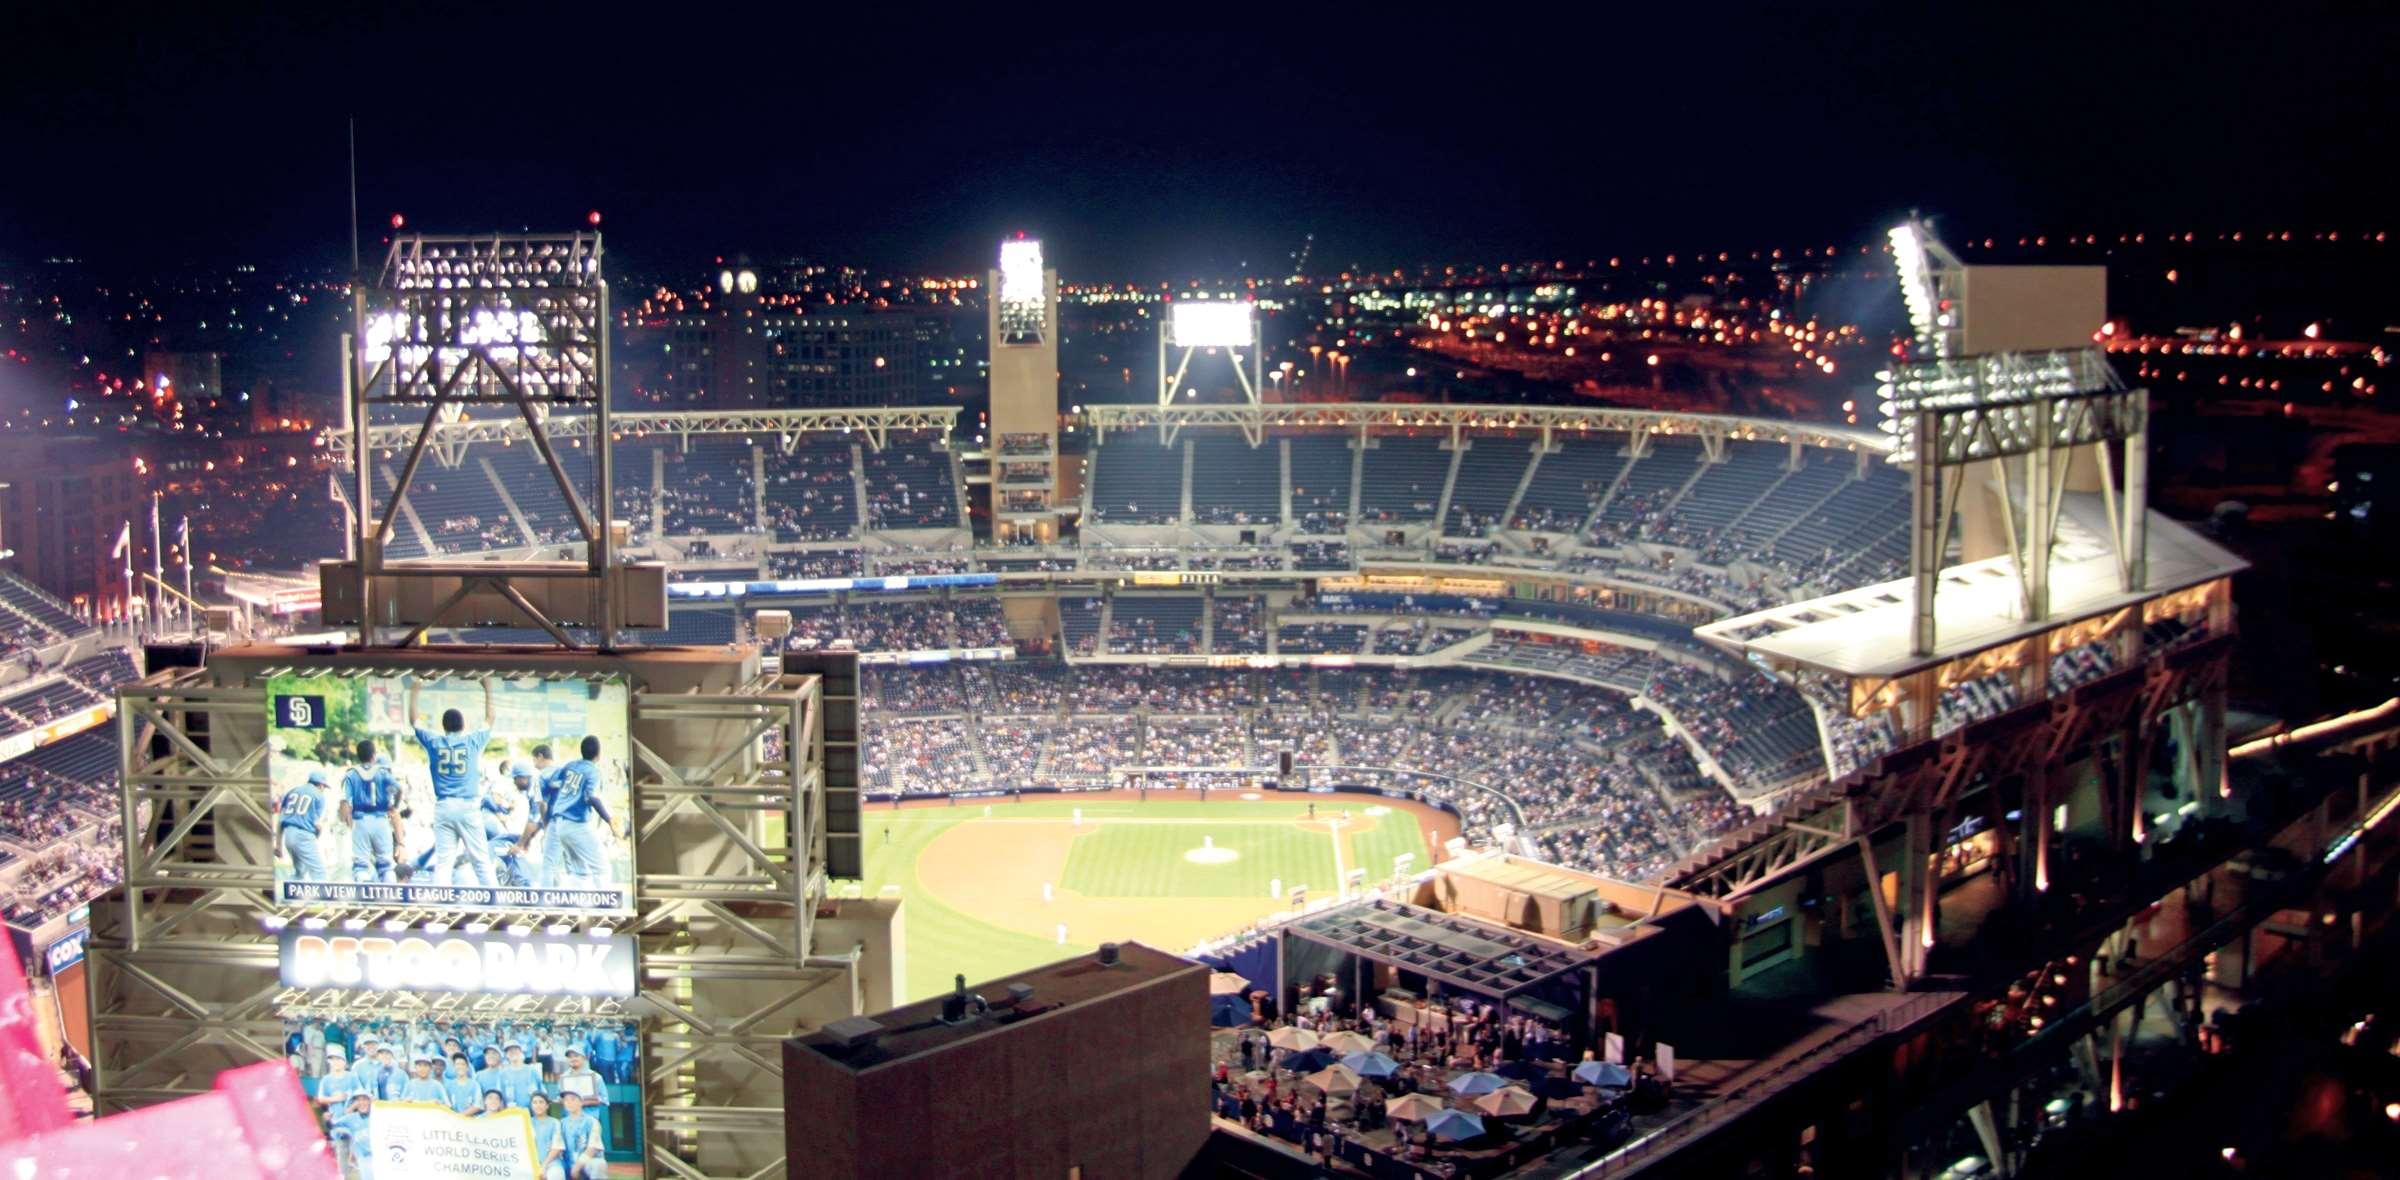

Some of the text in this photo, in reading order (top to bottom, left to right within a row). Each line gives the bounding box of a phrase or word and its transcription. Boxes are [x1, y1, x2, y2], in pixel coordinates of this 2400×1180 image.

[288, 696, 312, 726] SD
[437, 747, 469, 777] 25
[369, 781, 378, 808] 1
[561, 769, 585, 798] 24
[284, 793, 312, 816] 20
[289, 884, 618, 906] PARK VIEW LITTLE LEAGUE-2009 WORLD CHAMPIONS
[52, 933, 84, 966] COX
[484, 941, 614, 993] PARK
[422, 1129, 517, 1148] LITTLE LEAGUE
[424, 1145, 520, 1164] WORLD SERIES
[433, 1161, 512, 1178] CHAMPIONS
